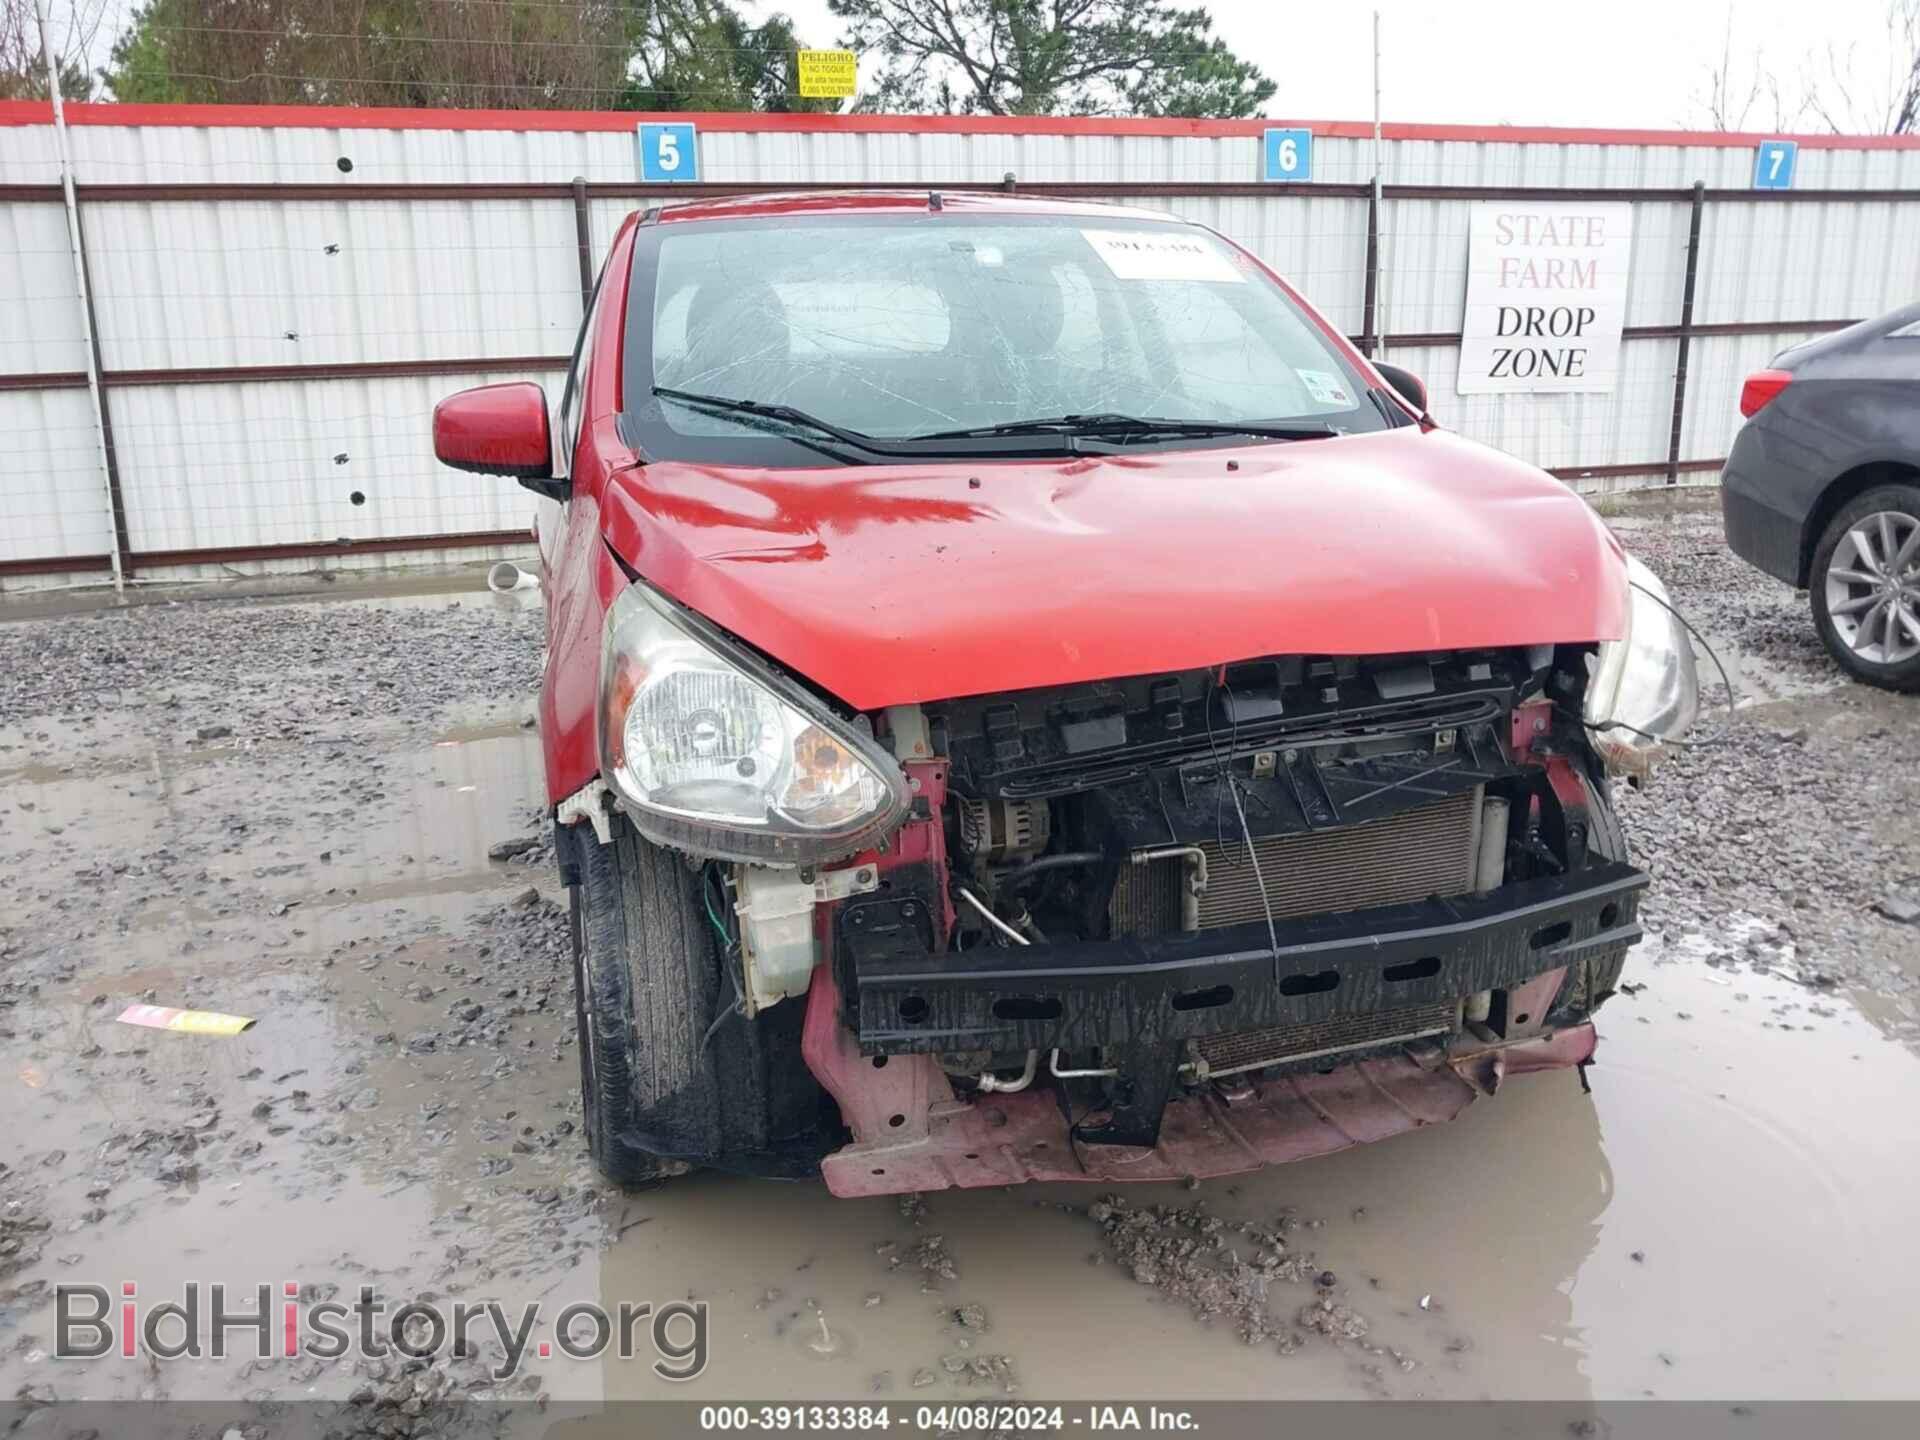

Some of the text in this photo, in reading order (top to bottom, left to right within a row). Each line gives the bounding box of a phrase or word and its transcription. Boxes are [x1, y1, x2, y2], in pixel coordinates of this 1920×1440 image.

[801, 52, 854, 62] PELIGRO
[808, 64, 846, 73] NO TOQUE
[659, 134, 680, 171] 5
[1279, 138, 1297, 171] 6
[1769, 150, 1784, 180] 7
[1495, 213, 1606, 248] STATE
[1496, 256, 1599, 290] FARM
[1496, 306, 1596, 338] DROP
[1488, 347, 1588, 379] ZONE
